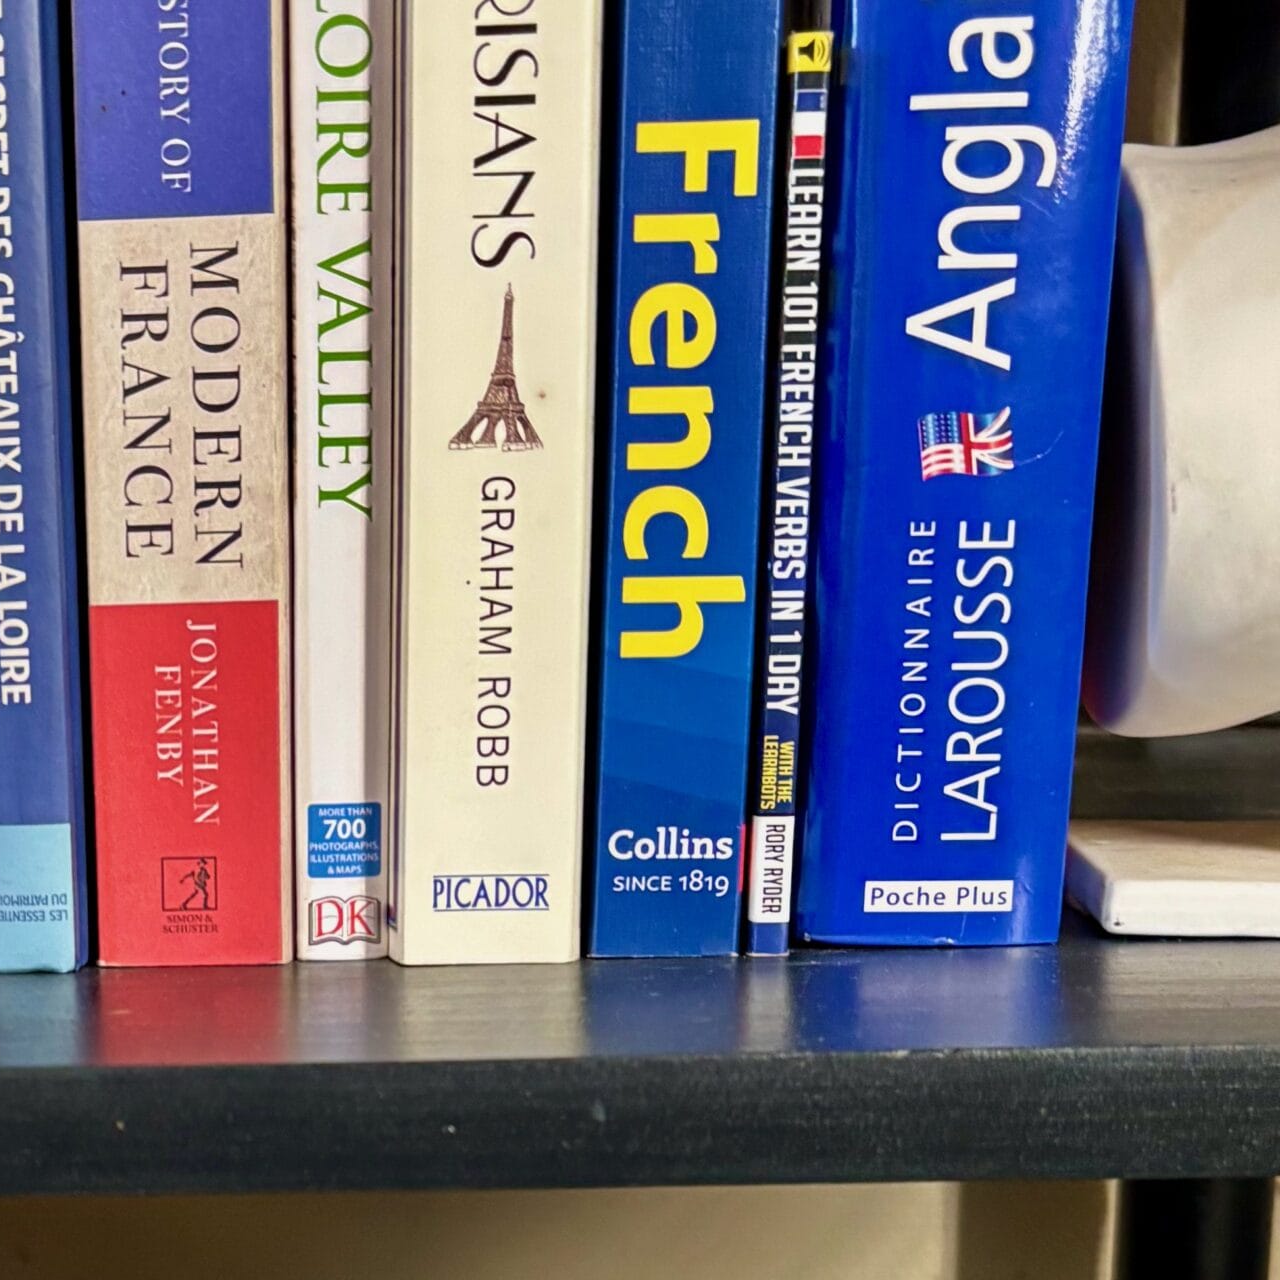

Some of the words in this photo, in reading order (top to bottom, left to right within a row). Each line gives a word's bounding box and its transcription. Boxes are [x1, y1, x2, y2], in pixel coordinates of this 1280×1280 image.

[160, 138, 192, 193] OF
[905, 15, 1057, 371] Angla
[786, 168, 825, 271] LEARN
[782, 283, 819, 333] 101
[189, 240, 244, 568] MODERN
[316, 238, 374, 522] VALLEY
[619, 119, 761, 660] French
[119, 260, 175, 559] FRANCE
[777, 344, 817, 468] FRENCH
[772, 477, 811, 580] VERBS
[477, 476, 516, 656] GRAHAM
[770, 589, 806, 622] IN
[769, 630, 803, 646] 1
[766, 653, 803, 716] DAY
[892, 520, 936, 842] DICTIONNAIRE
[939, 519, 1017, 841] LAROUSSE
[154, 664, 185, 787] FENBY
[186, 619, 220, 826] JONATHAN
[476, 676, 512, 787] ROBB
[761, 735, 780, 811] LEARNBOTS
[777, 740, 795, 777] WITH
[318, 807, 346, 817] MORE
[347, 807, 372, 816] THAN
[776, 779, 793, 804] THE
[323, 818, 366, 839] 700
[607, 828, 734, 861] Collins
[762, 823, 786, 865] RORY
[336, 865, 362, 874] MAPS
[432, 876, 550, 910] PICADOR
[612, 876, 673, 892] SINCE
[677, 873, 730, 897] 1819
[760, 868, 784, 915] RYDER
[49, 909, 68, 921] LES
[51, 893, 68, 906] DU
[166, 914, 202, 924] SIMON
[315, 899, 376, 938] DK
[870, 885, 947, 907] Poche
[957, 884, 1008, 906] Plus
[162, 924, 219, 934] SCHUSTER
